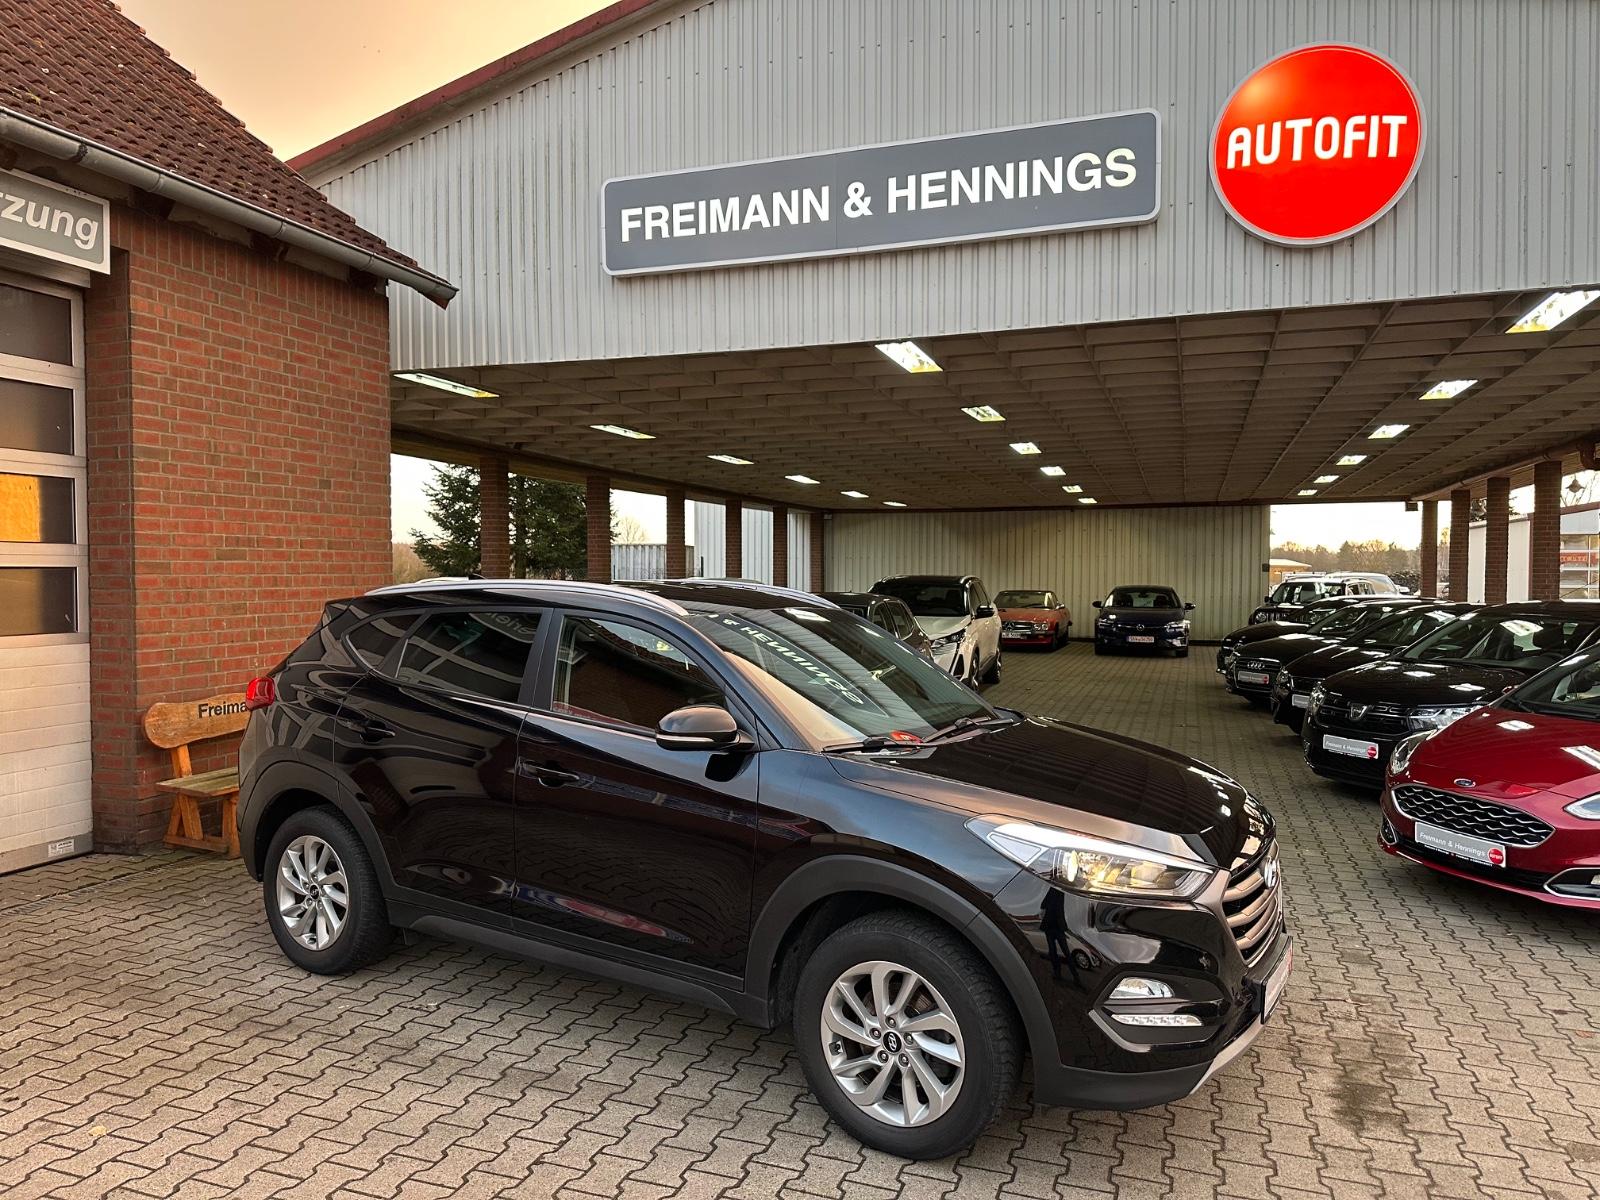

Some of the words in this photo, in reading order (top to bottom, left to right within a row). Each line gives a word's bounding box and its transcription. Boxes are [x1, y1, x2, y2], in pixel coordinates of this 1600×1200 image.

[1226, 115, 1408, 169] AUTOFIT
[0, 192, 99, 250] zung
[619, 185, 831, 242] FREIMANN
[843, 182, 873, 218] &
[887, 148, 1137, 213] HENNINGS
